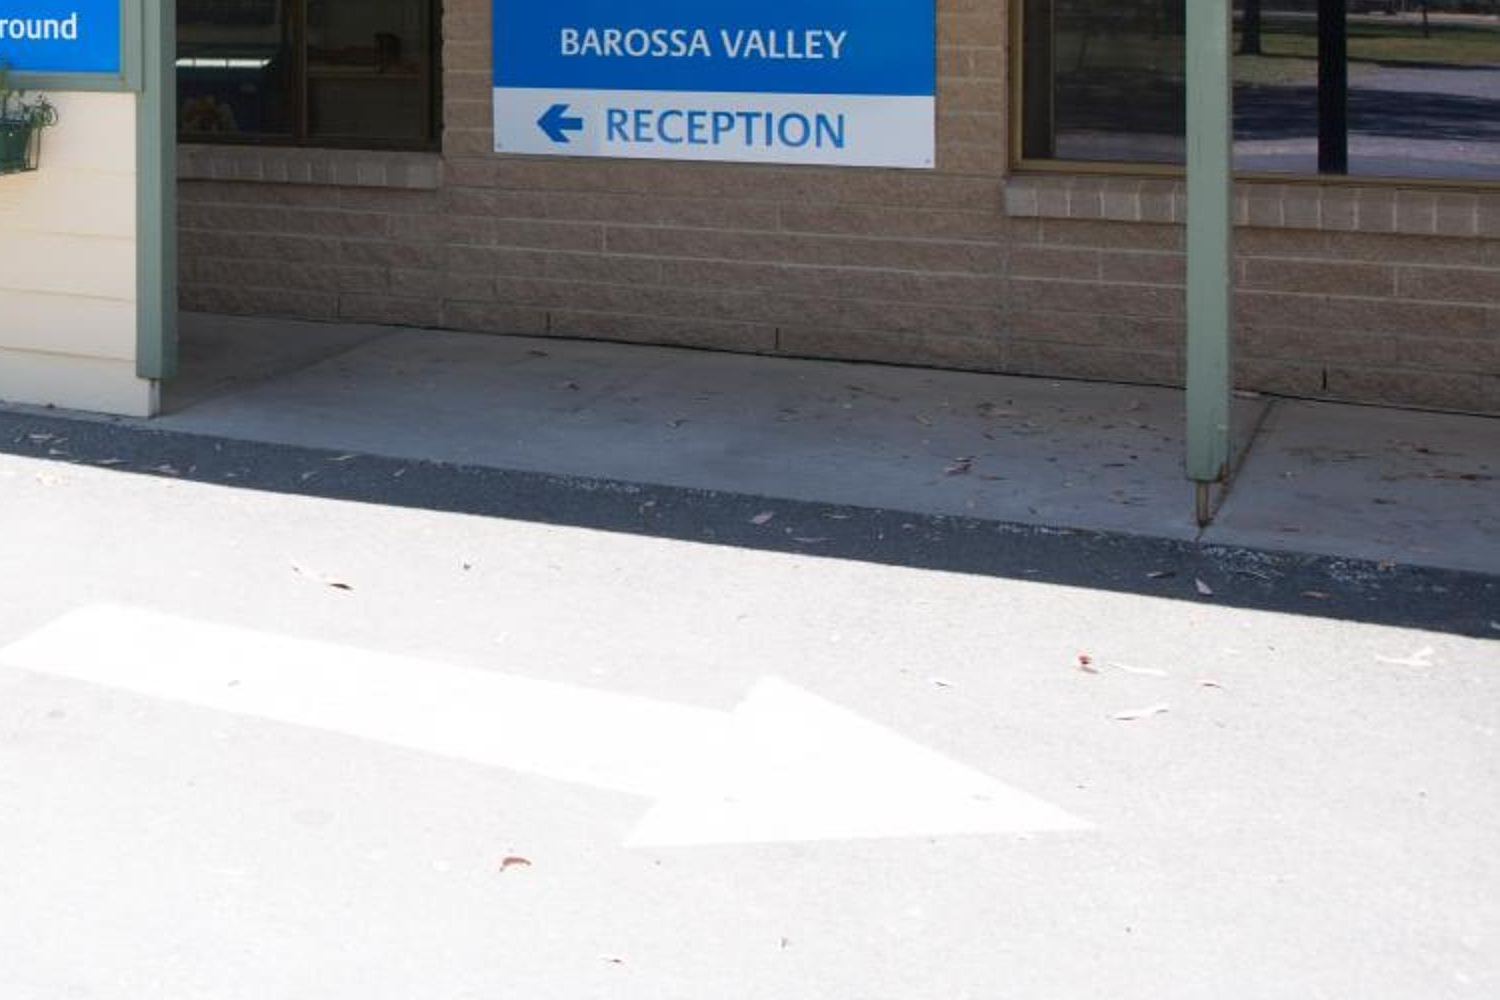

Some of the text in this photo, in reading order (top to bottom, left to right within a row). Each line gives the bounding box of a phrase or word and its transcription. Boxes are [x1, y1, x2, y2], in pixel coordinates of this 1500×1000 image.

[561, 28, 847, 59] BAROSSA VALLEY
[606, 108, 845, 149] RECEPTION
